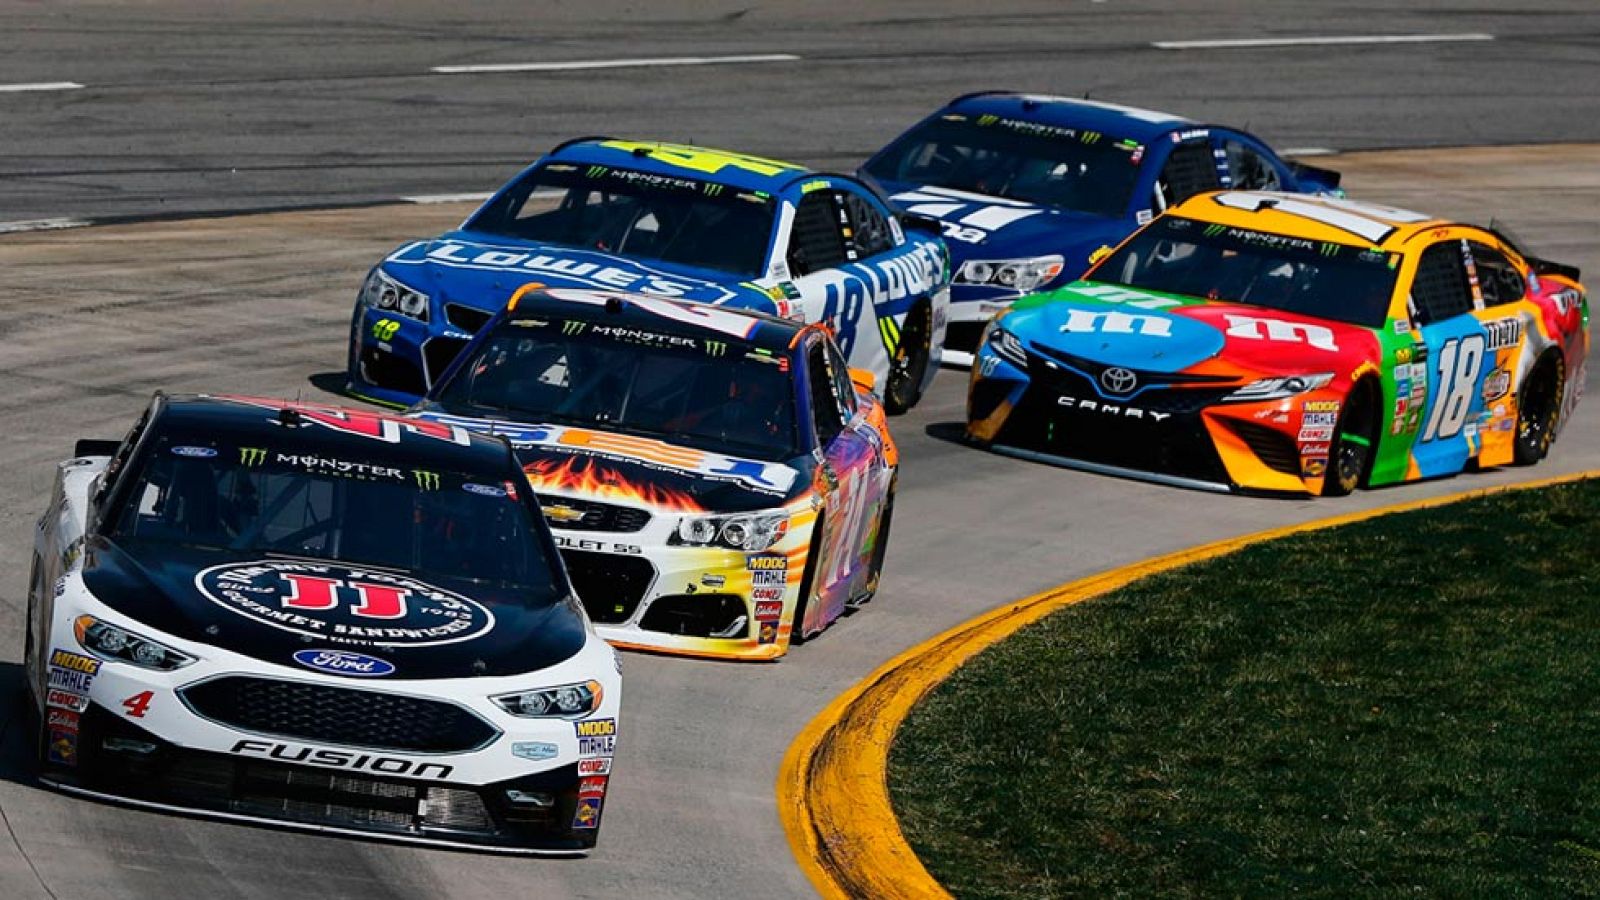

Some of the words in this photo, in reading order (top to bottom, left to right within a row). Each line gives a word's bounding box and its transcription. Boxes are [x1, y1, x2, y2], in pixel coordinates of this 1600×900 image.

[1000, 117, 1076, 139] MONSTER
[611, 170, 697, 190] MONSTER
[1228, 229, 1314, 250] MONSTER
[425, 242, 704, 297] LOWE'S
[372, 318, 400, 341] 48
[1058, 308, 1173, 338] m
[1223, 313, 1340, 353] m
[592, 324, 698, 349] MONSTER
[1423, 334, 1484, 441] 18
[276, 453, 404, 480] MONSTER
[613, 543, 642, 555] SS
[750, 556, 786, 569] MOOG
[753, 571, 786, 584] MAHLE
[280, 572, 413, 620] JJ
[221, 589, 326, 629] GOURMET
[53, 651, 98, 674] MOOG
[312, 650, 376, 674] Ford
[51, 667, 93, 692] MAHLE
[122, 690, 155, 718] 4
[577, 720, 614, 736] MOOG
[579, 738, 613, 754] MAHLE
[228, 738, 455, 779] FUSION
